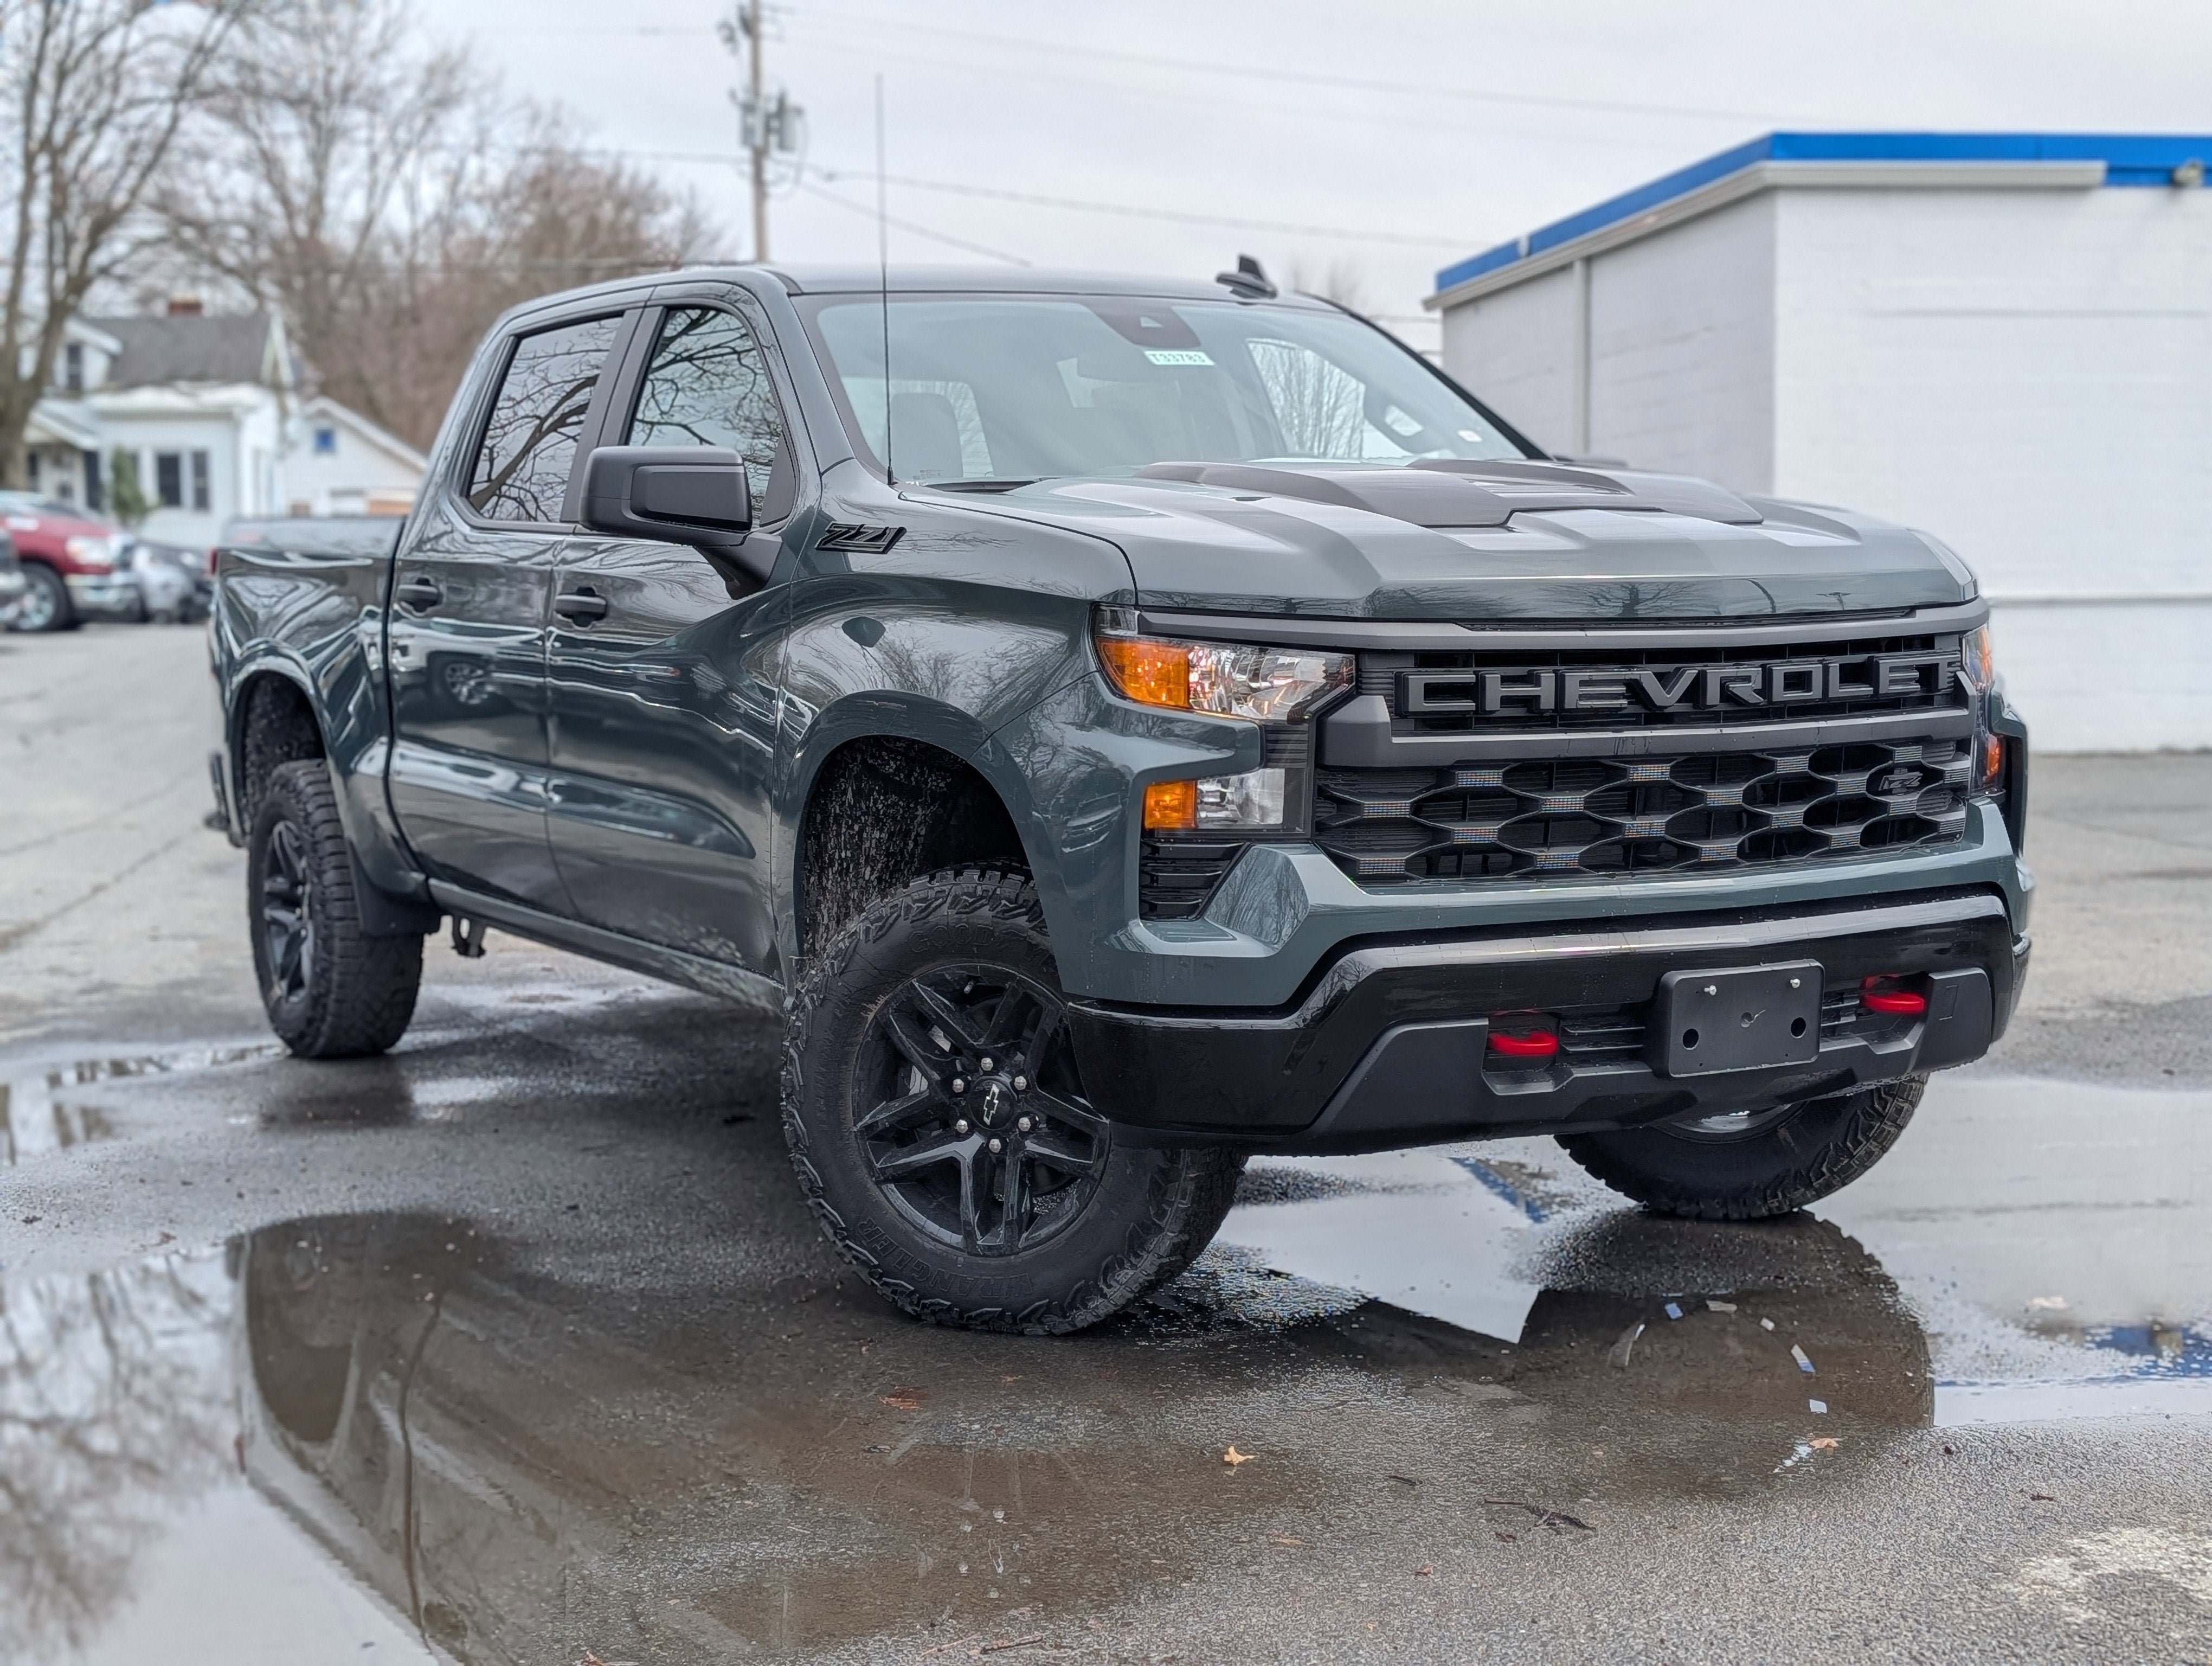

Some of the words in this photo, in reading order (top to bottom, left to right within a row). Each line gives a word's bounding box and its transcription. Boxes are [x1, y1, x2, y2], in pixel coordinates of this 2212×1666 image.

[814, 521, 907, 554] Z71
[1396, 653, 1957, 716] CHEVROLET
[857, 1216, 1033, 1299] WRANGLER
